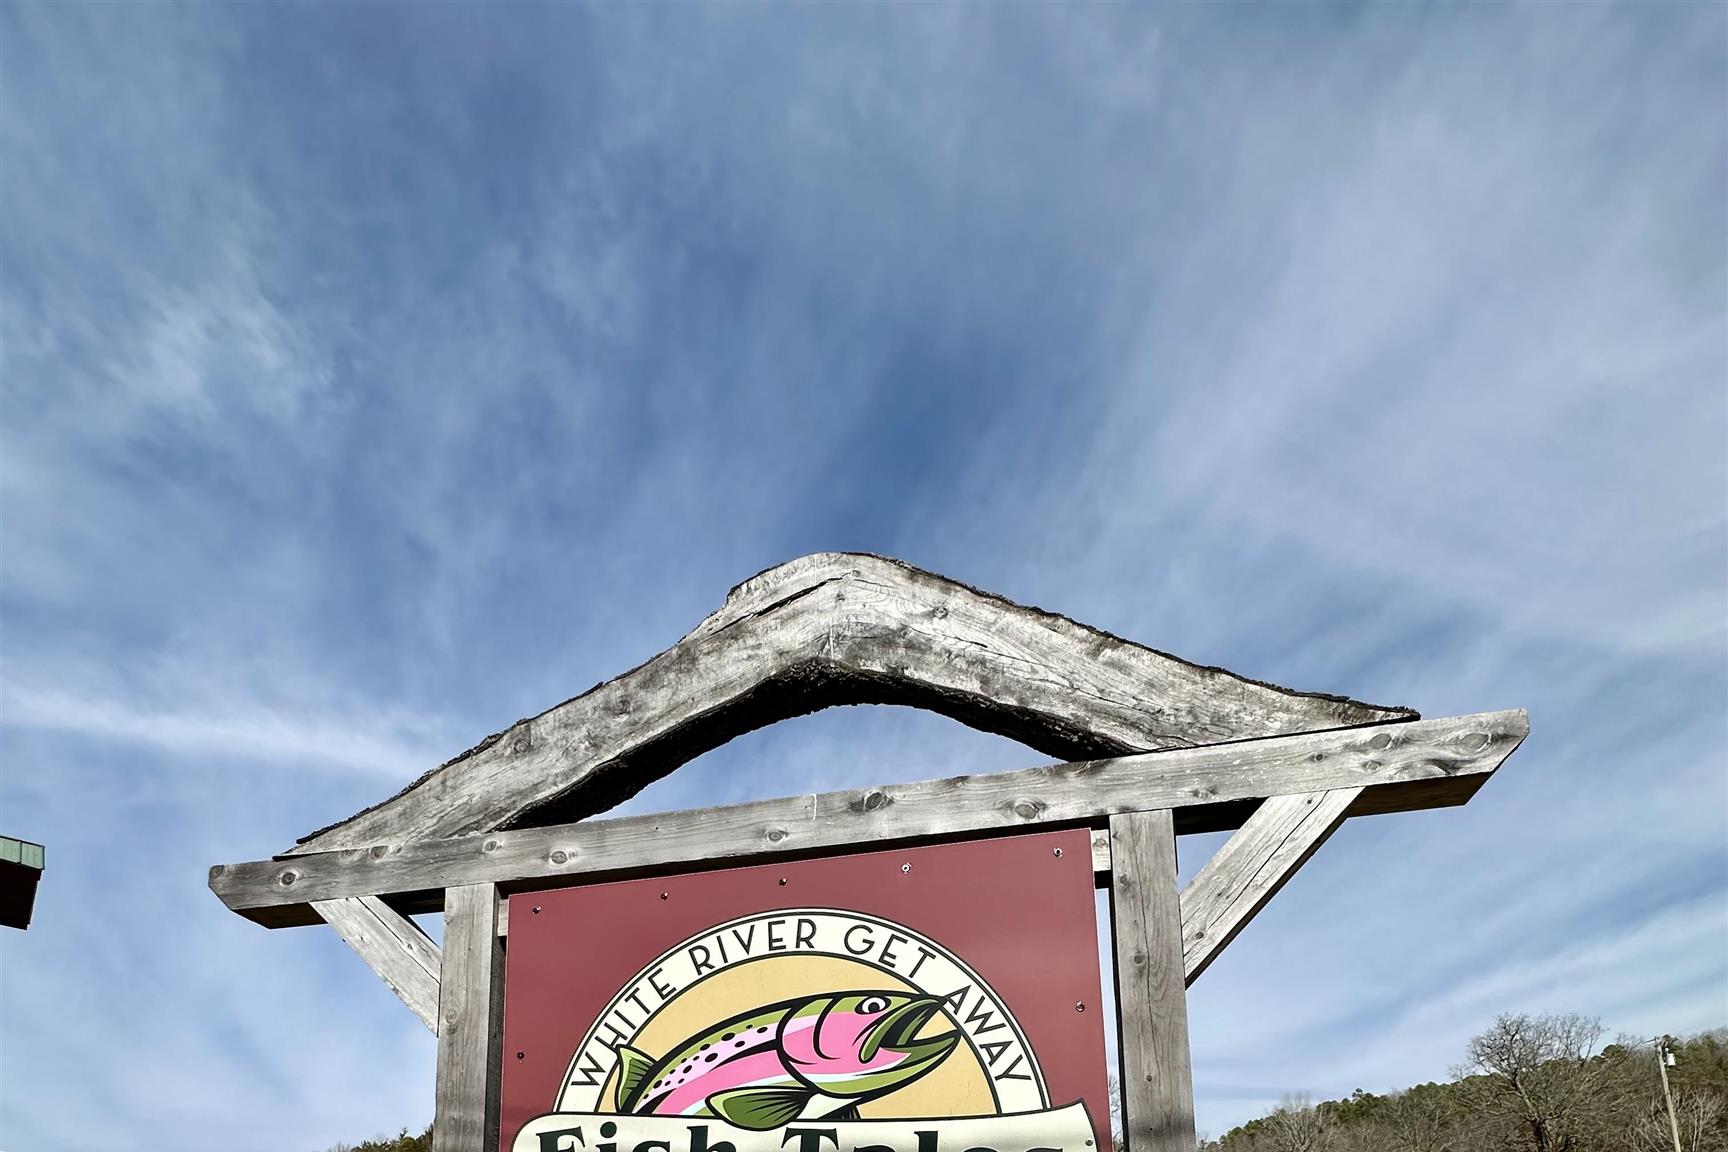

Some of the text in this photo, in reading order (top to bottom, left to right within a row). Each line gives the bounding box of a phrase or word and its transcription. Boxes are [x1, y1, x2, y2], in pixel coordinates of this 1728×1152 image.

[571, 919, 1032, 1088] WHITE RIVER GET AWAY
